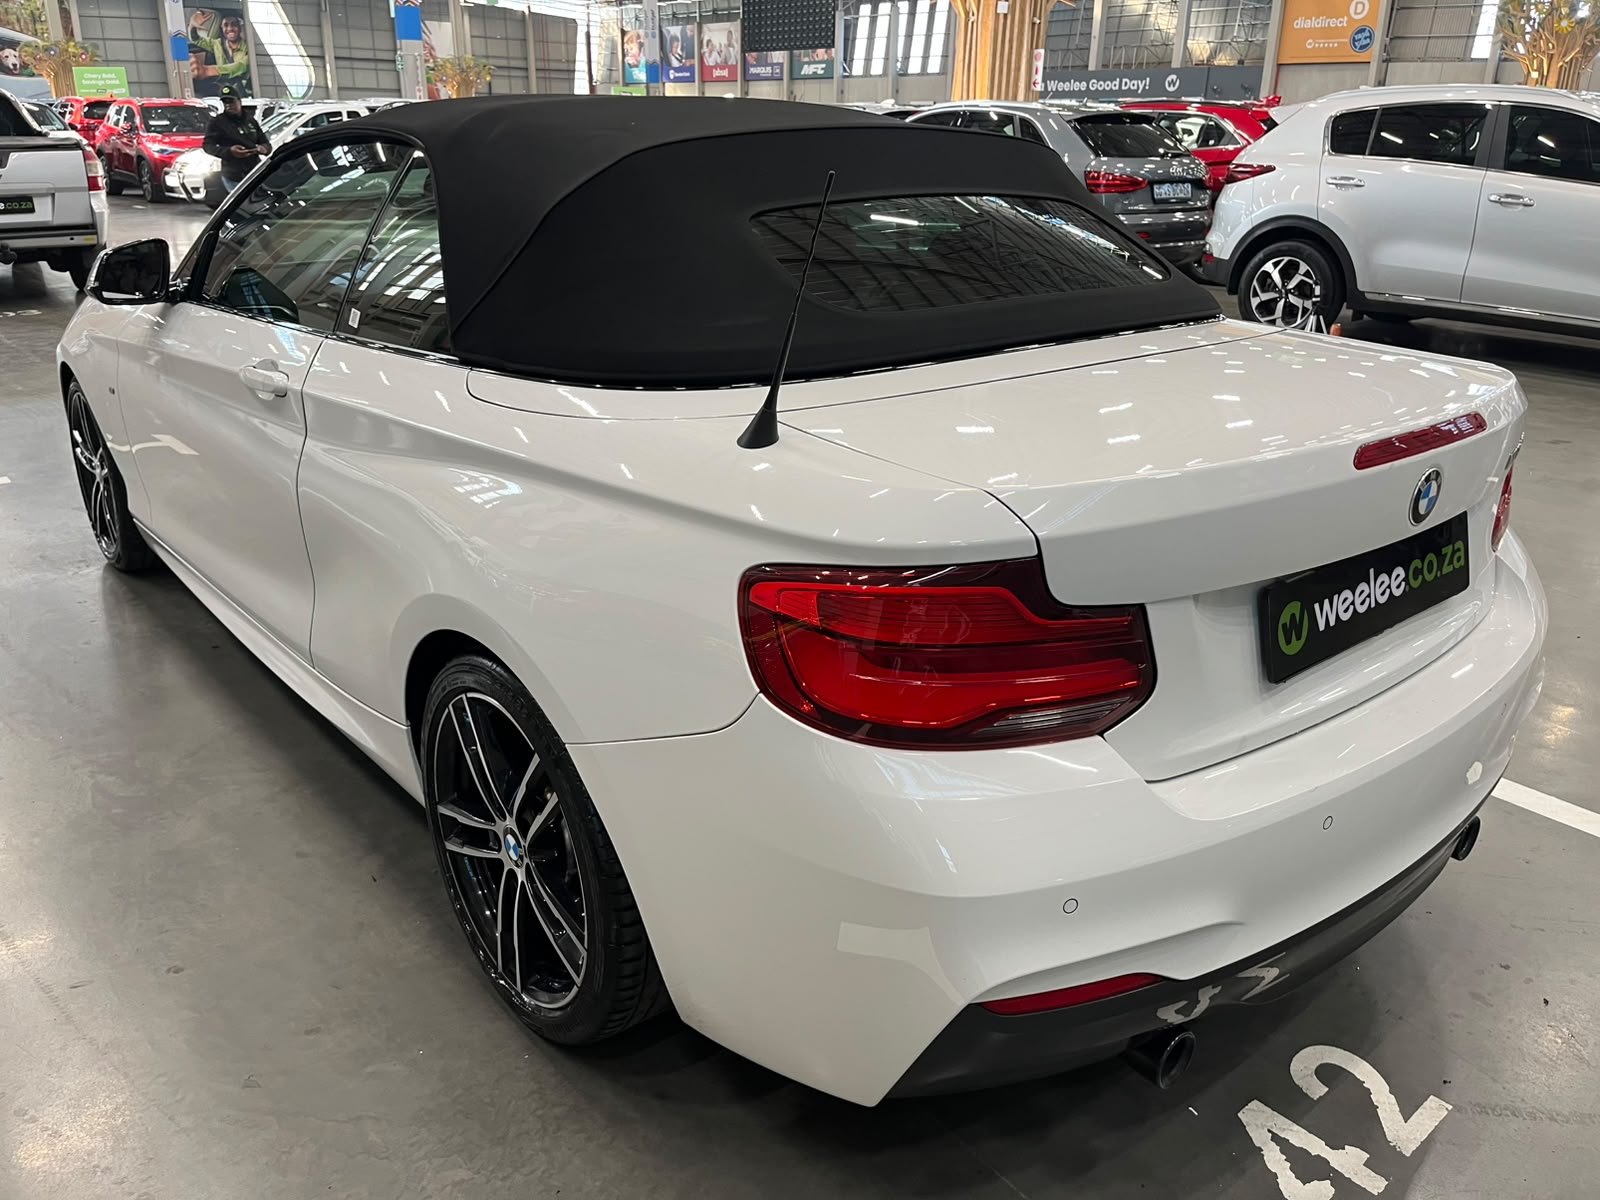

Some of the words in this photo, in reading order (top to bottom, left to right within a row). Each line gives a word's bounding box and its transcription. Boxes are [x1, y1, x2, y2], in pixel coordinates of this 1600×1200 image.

[1293, 15, 1348, 29] dialdirect
[801, 63, 826, 75] MFC
[1047, 79, 1087, 92] Weelee
[1089, 77, 1119, 91] Good
[1122, 77, 1150, 94] Day!
[1313, 539, 1466, 632] weelee.co.za
[1237, 1044, 1454, 1200] 42
